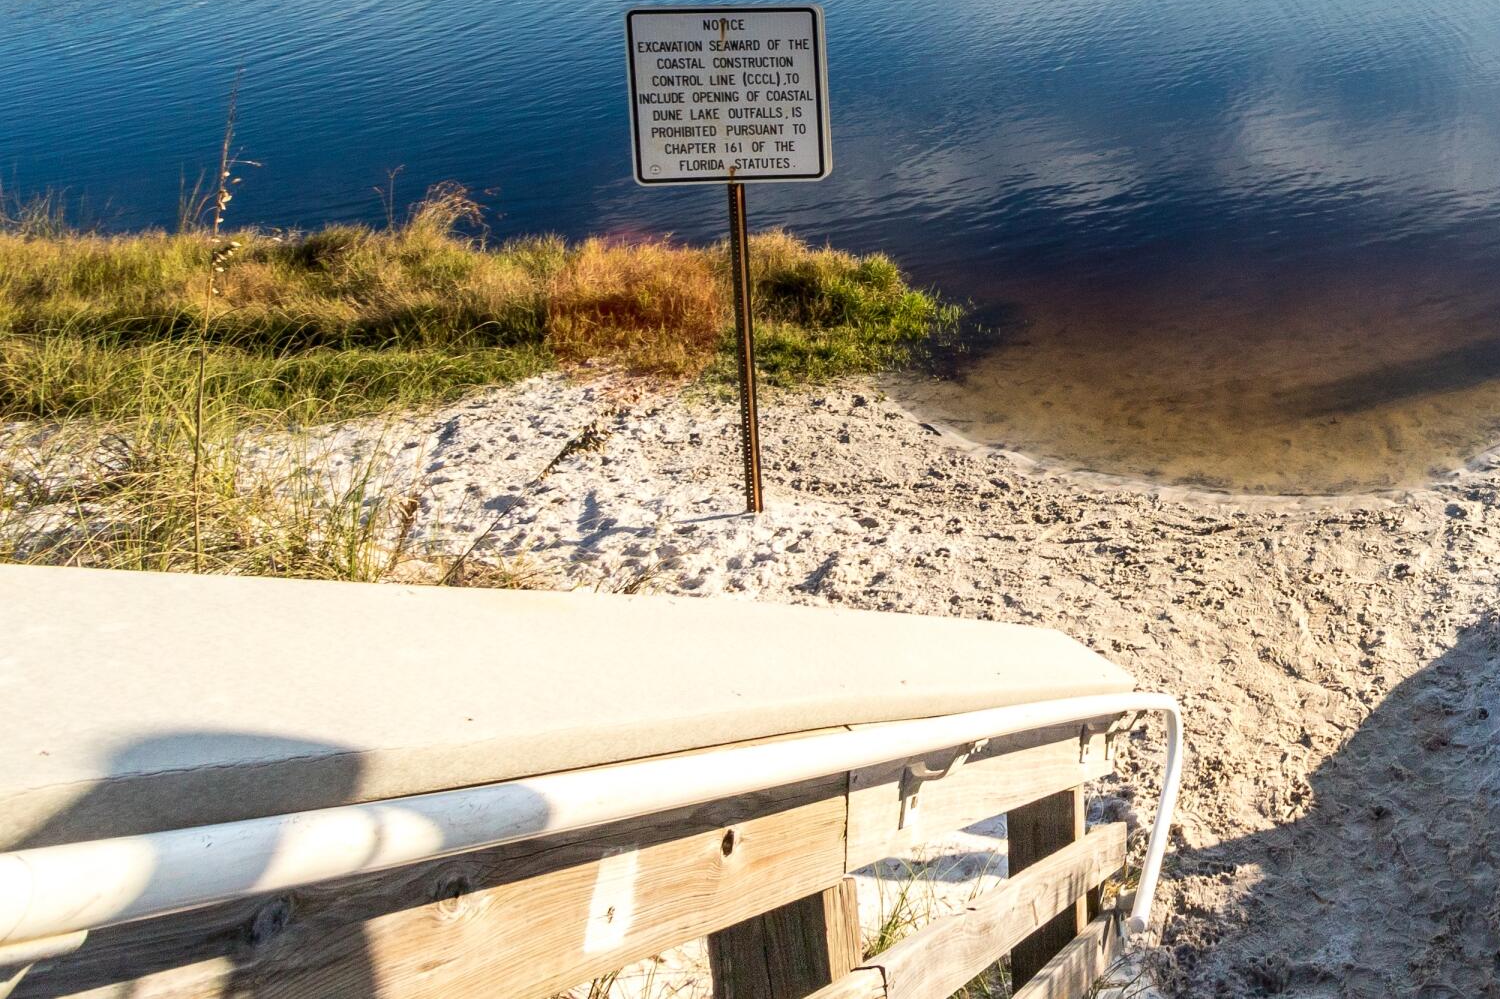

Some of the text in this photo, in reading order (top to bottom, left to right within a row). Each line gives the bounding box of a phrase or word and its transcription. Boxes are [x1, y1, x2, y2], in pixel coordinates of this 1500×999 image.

[703, 19, 744, 31] NOTICE
[638, 39, 809, 53] EXCAVATION SEAWARD OF THE
[657, 57, 793, 69] COASTAL CONSTRUCTION
[652, 75, 700, 86] CONTROL
[710, 74, 735, 86] LINE
[786, 72, 799, 84] TO
[639, 90, 812, 104] INCLUDE OPENING OF COASTAL
[653, 110, 682, 121] DUNE
[690, 109, 719, 120] LAKE
[792, 107, 802, 118] IS
[651, 124, 806, 138] PROHIBITED PURSUANT TO
[665, 141, 795, 155] CHAPTER 161 OF THE
[680, 158, 795, 171] FLORIDA STATUTES.
